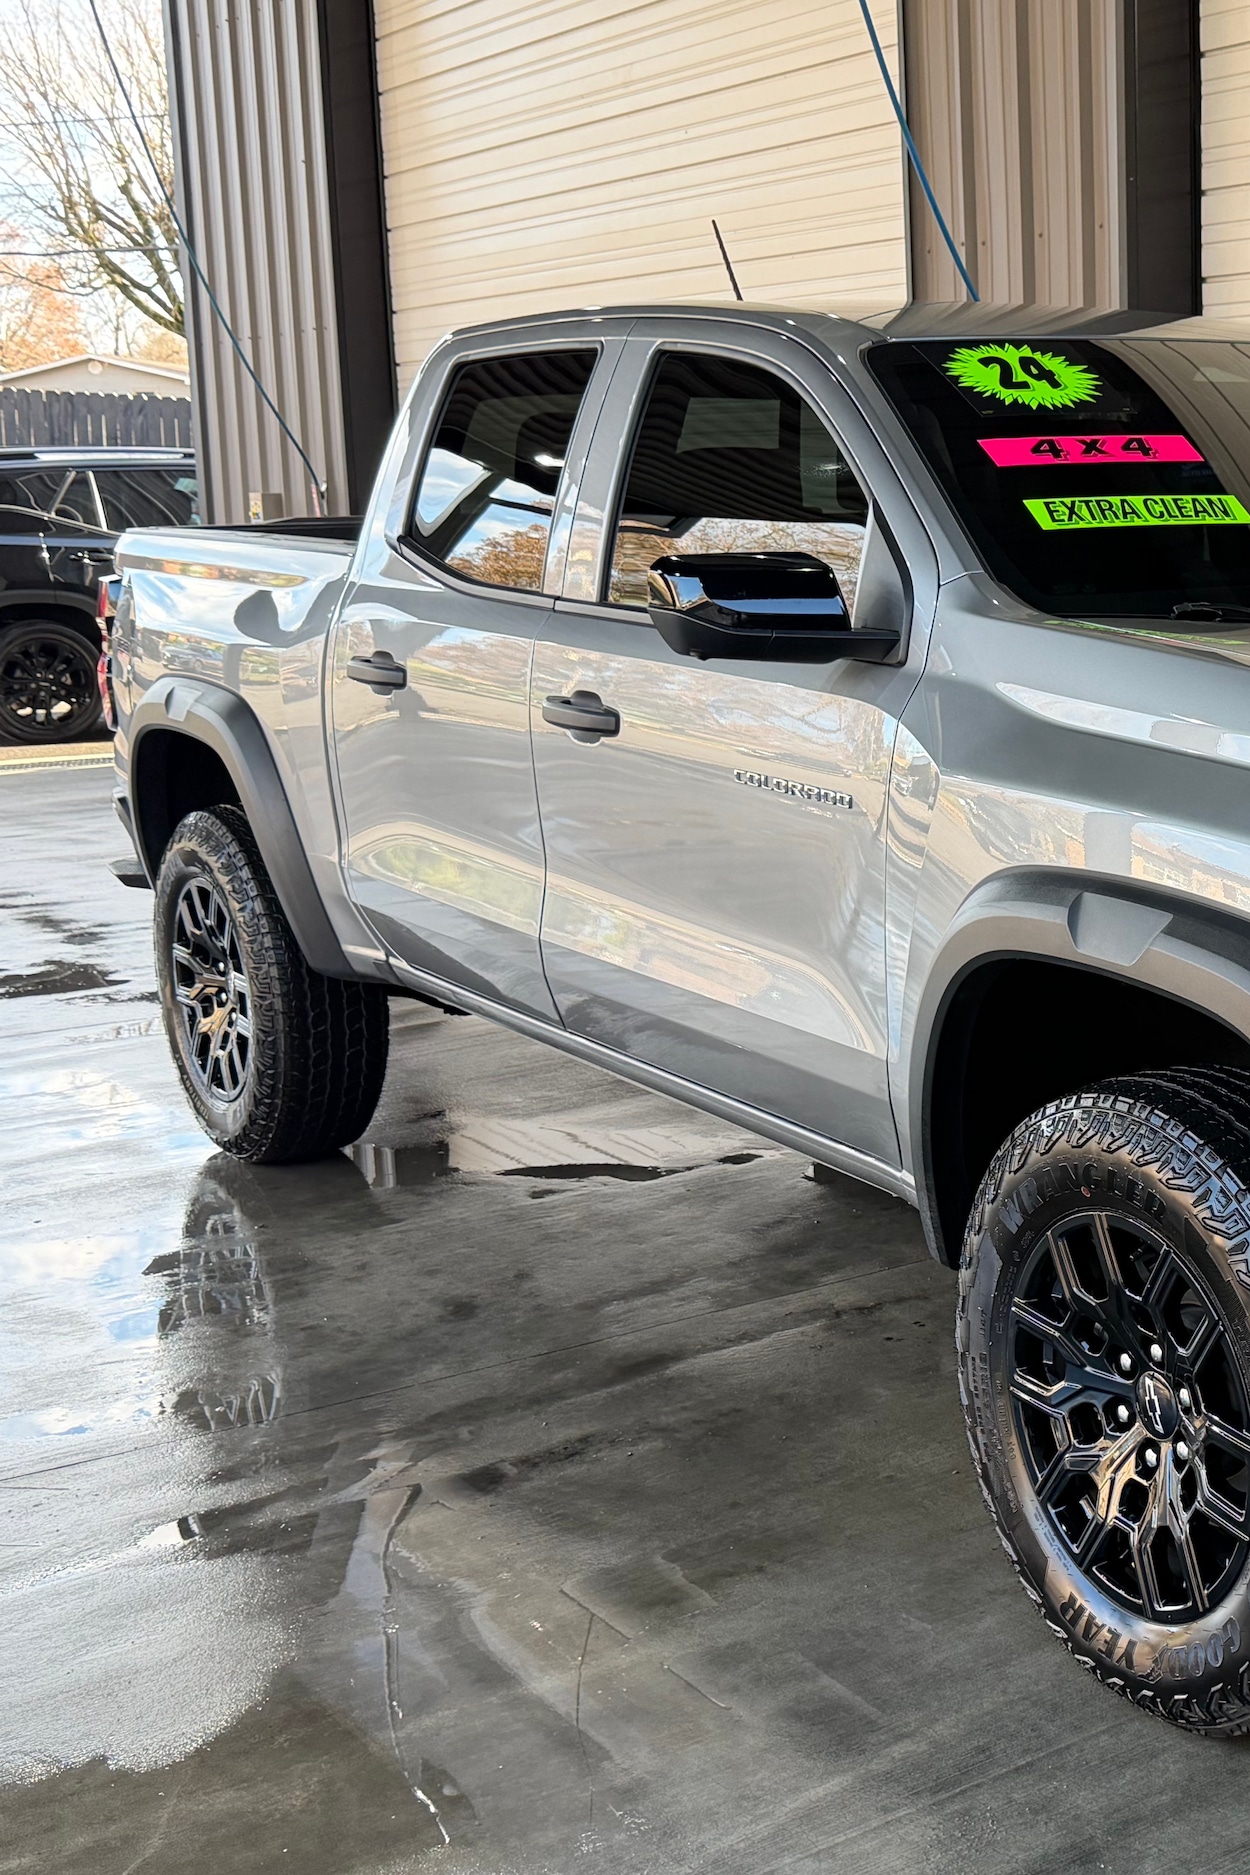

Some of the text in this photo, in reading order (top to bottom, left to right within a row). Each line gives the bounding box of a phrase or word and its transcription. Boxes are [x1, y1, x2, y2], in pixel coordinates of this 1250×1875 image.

[977, 356, 1065, 390] 24
[1044, 497, 1233, 524] EXTRA CLEAN
[734, 768, 853, 809] COLORADO
[999, 1162, 1168, 1235] WRANGLER
